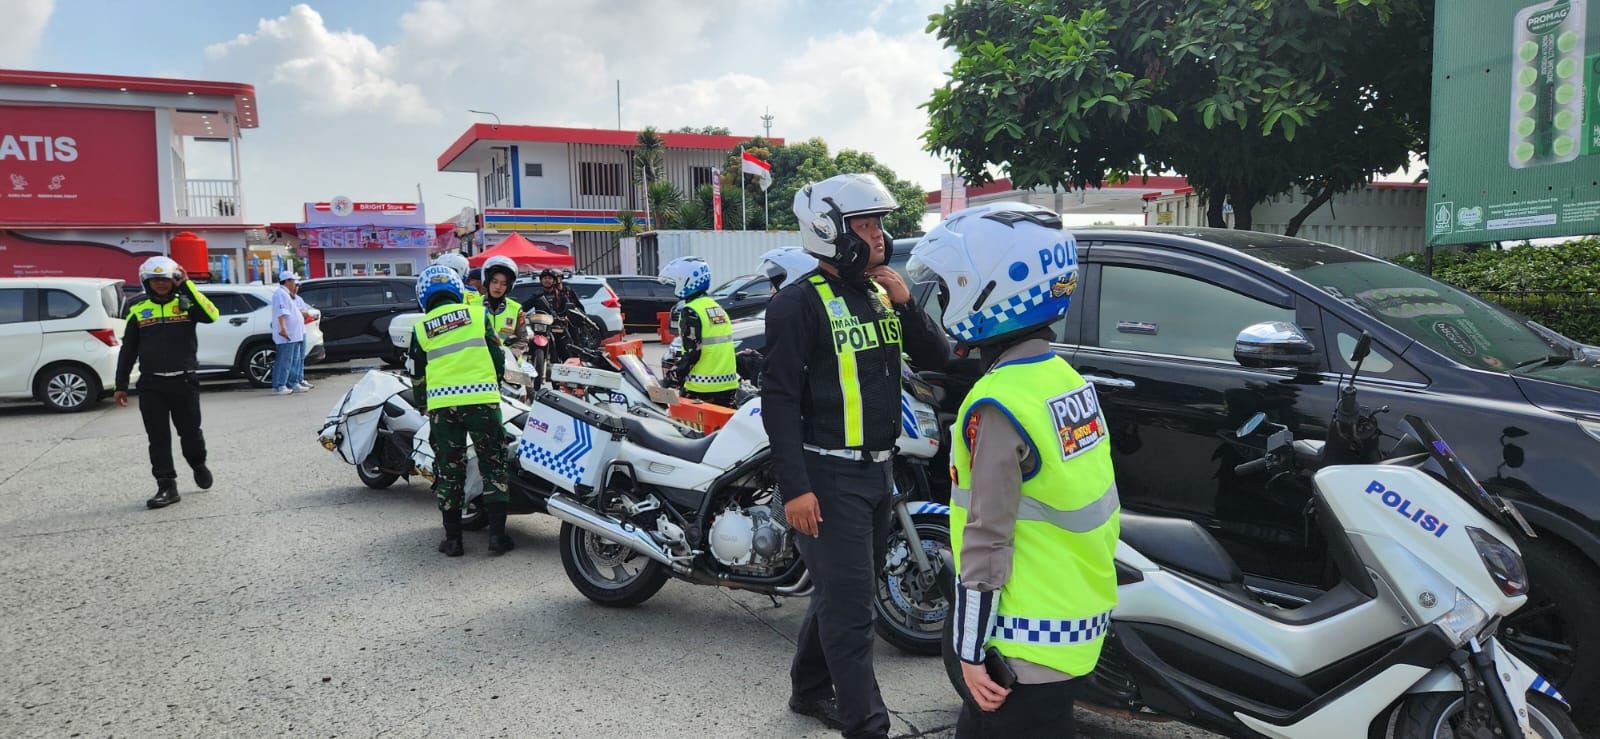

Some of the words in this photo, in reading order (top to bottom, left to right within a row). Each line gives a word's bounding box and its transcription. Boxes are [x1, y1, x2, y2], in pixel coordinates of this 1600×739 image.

[1528, 9, 1567, 26] PROMAG
[0, 134, 78, 162] ATIS
[1039, 240, 1077, 275] POLI
[1365, 480, 1449, 538] POLISI
